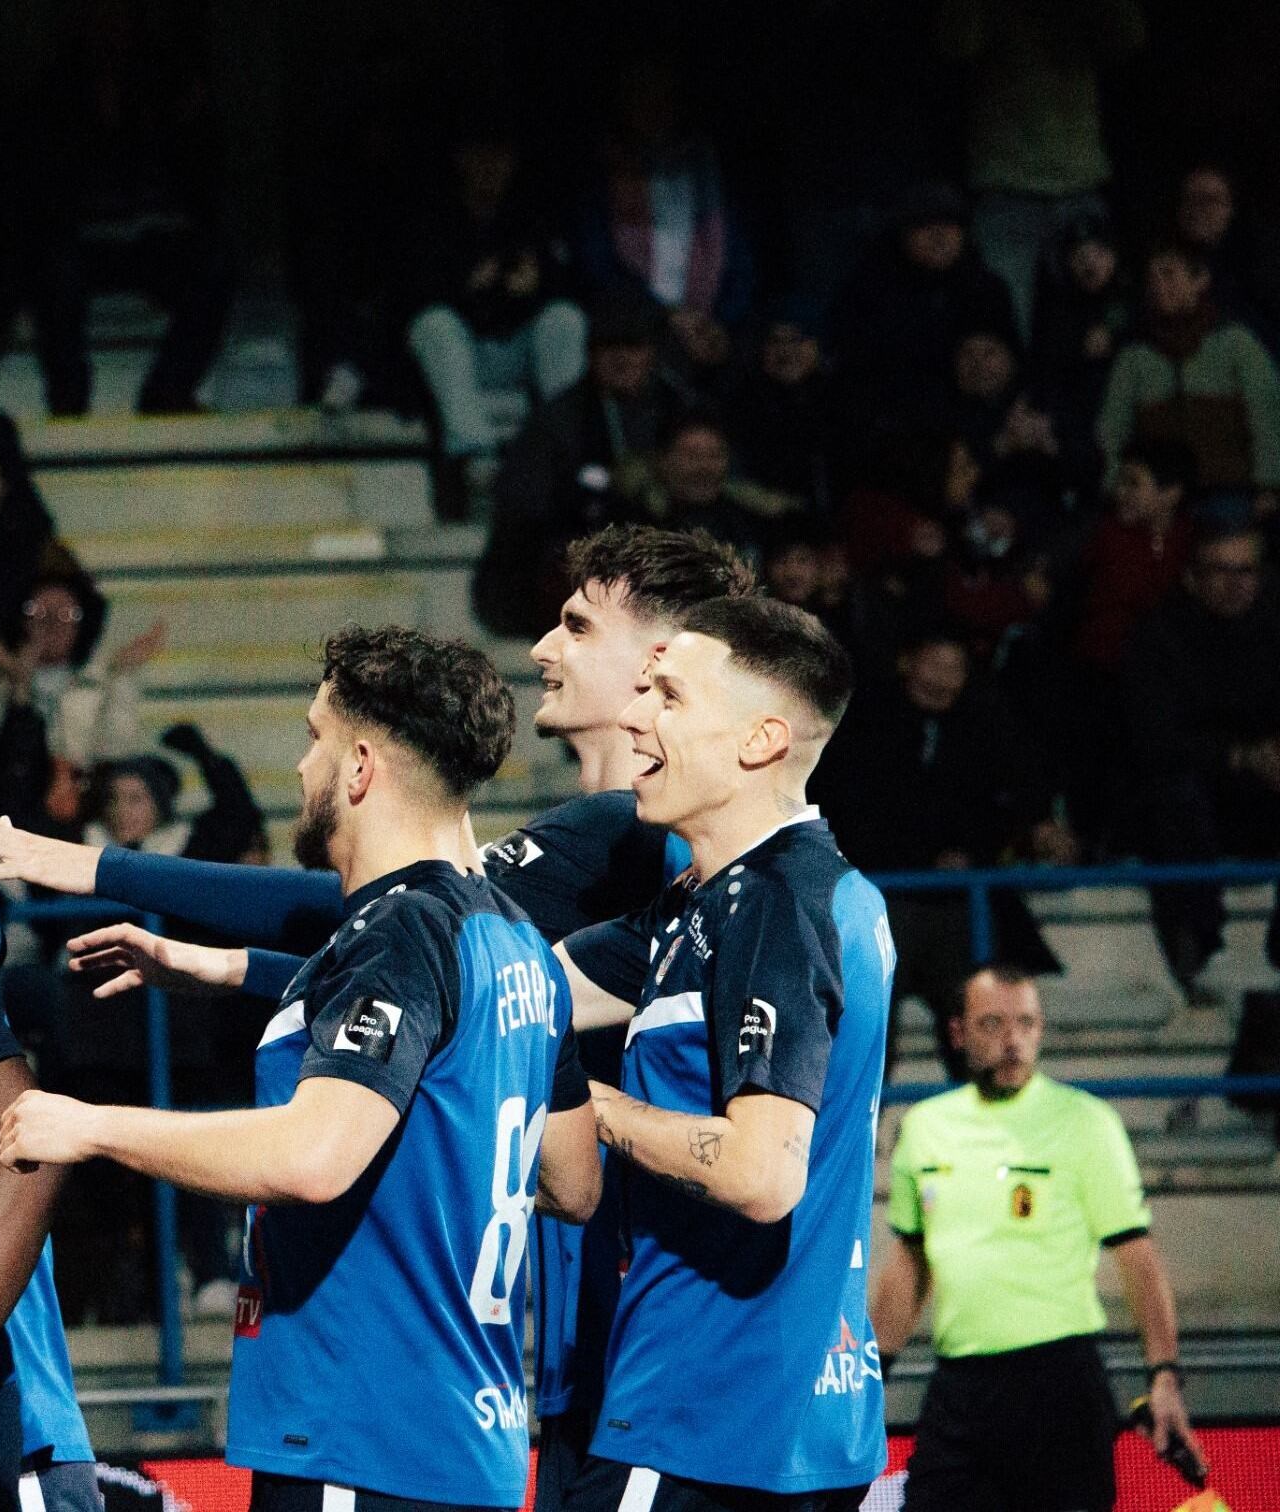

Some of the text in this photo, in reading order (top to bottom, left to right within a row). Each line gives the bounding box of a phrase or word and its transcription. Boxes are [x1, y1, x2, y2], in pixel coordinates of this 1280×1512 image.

[360, 1014, 377, 1025] Pro
[744, 1014, 761, 1024] Pro
[348, 1024, 384, 1037] League
